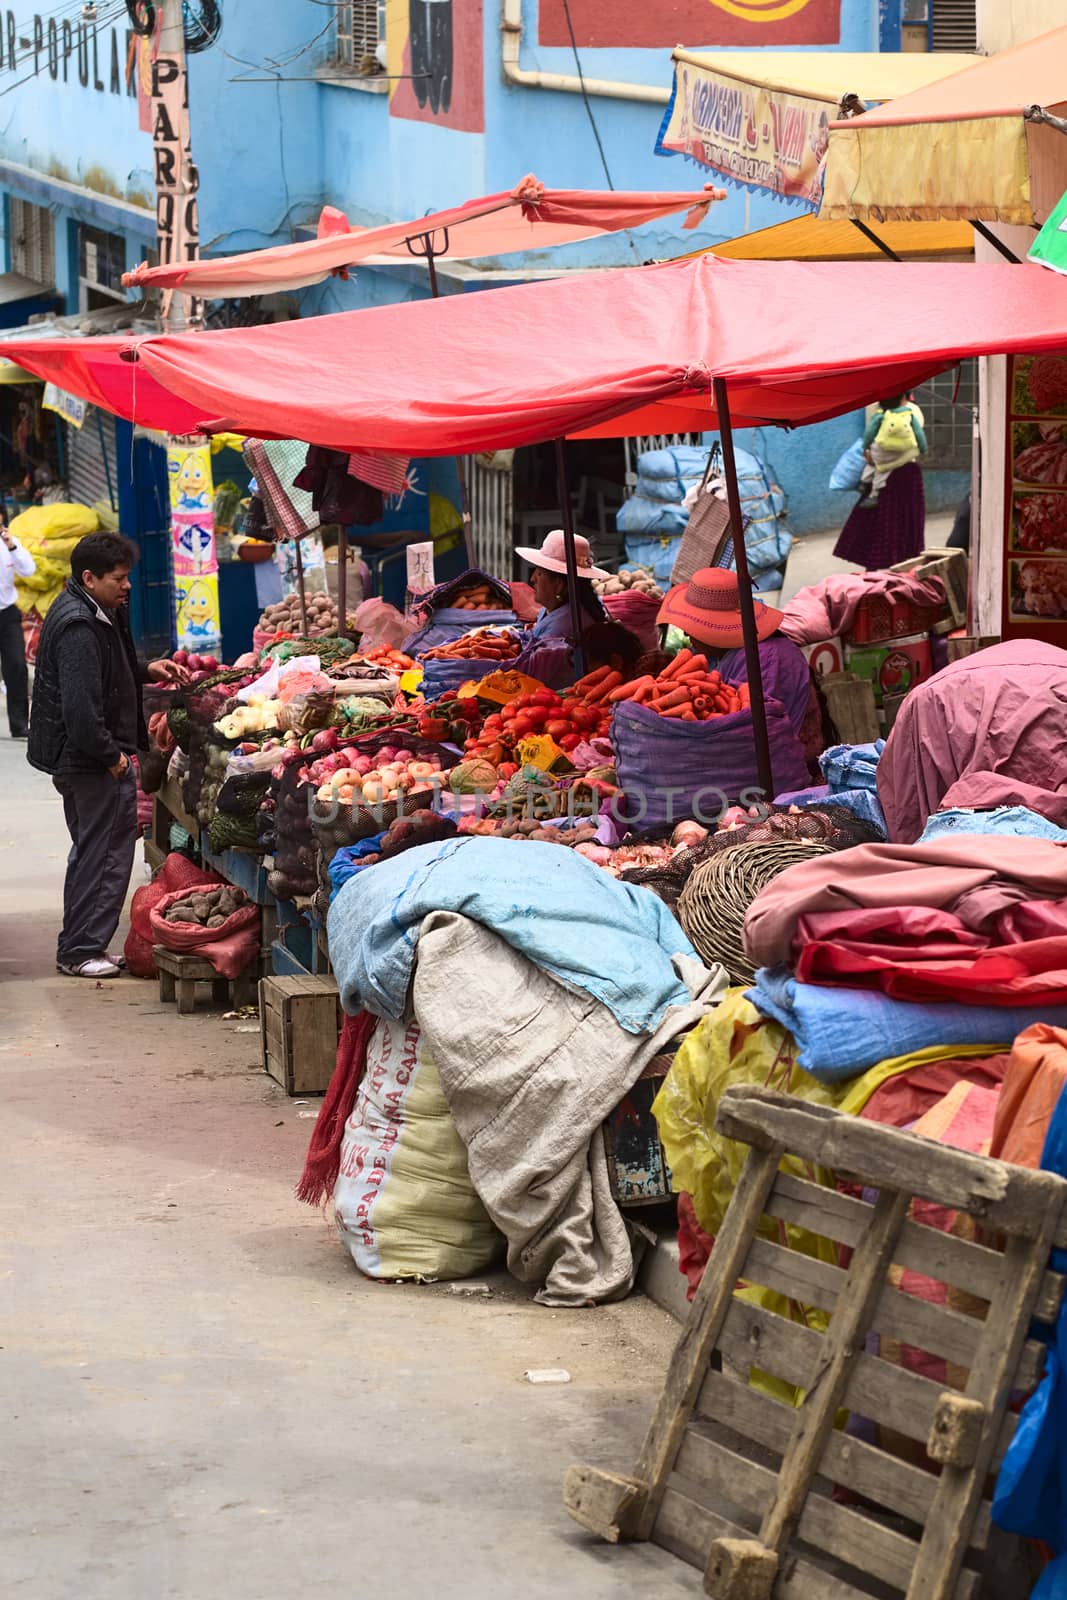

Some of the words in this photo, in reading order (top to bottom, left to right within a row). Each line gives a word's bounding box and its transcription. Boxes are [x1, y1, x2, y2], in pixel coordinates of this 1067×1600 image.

[151, 59, 179, 265] PARQU
[366, 1156, 386, 1185] DE
[356, 1189, 378, 1245] PAPA
